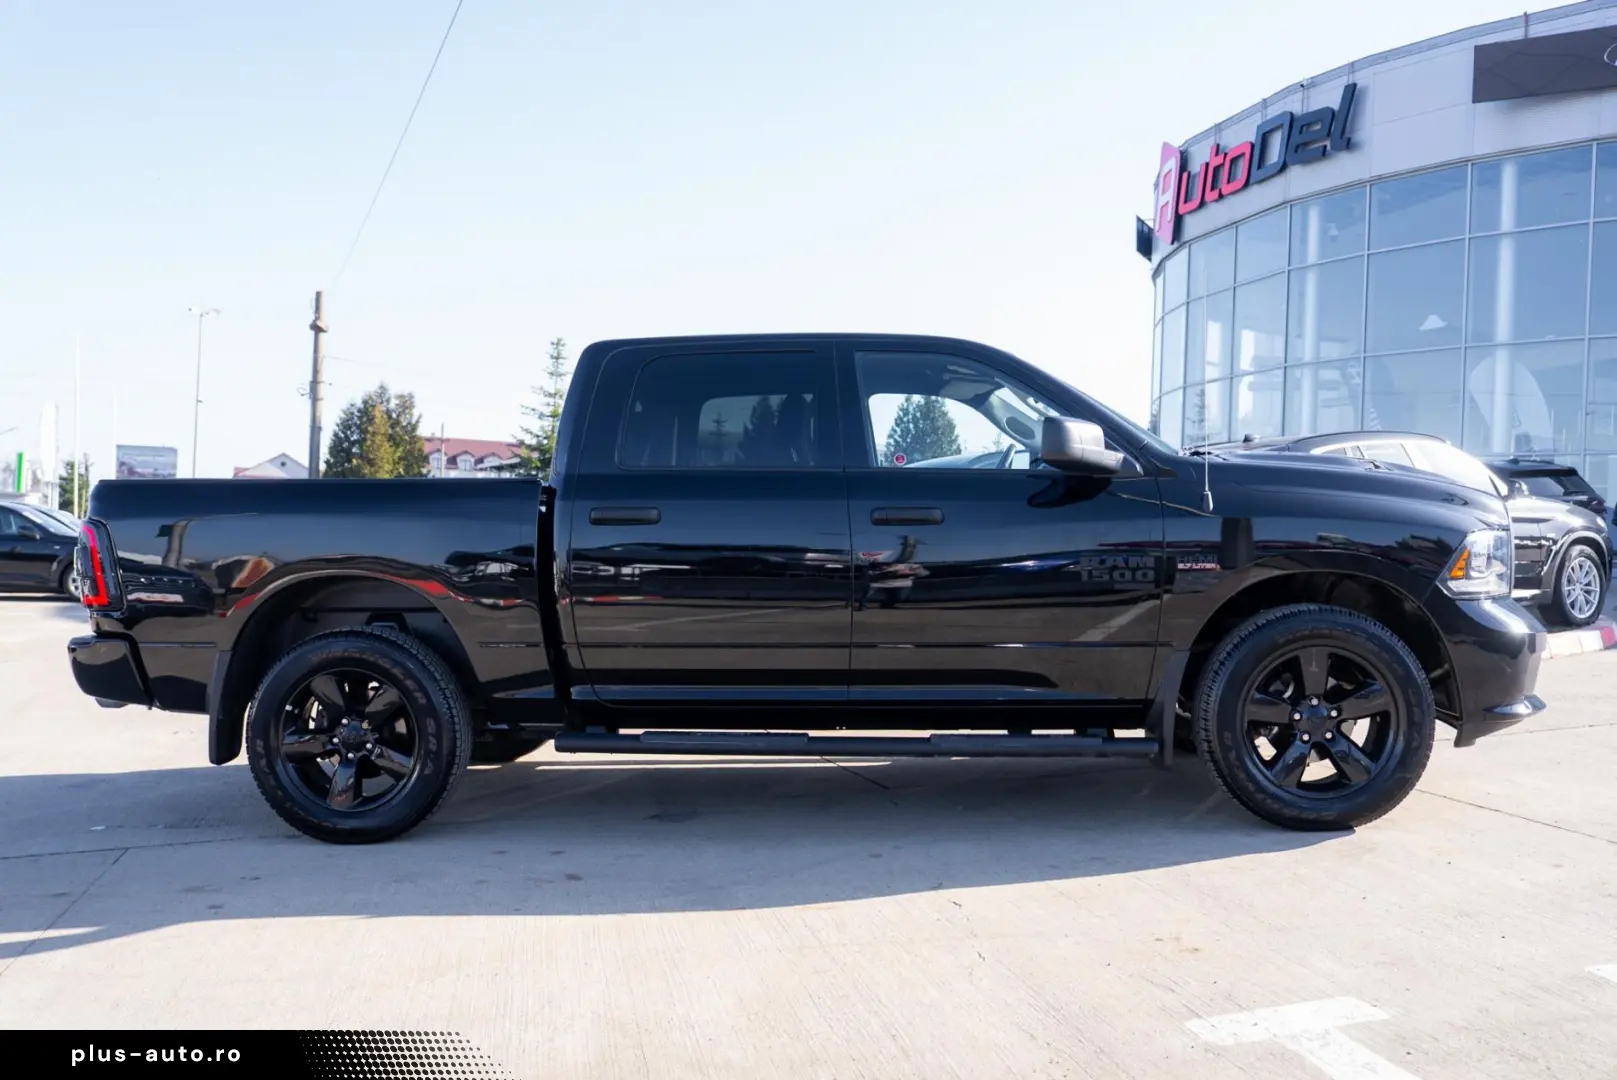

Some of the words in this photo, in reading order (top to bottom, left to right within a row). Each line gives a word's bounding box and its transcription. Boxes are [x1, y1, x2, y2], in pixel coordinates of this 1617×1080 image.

[1154, 83, 1357, 234] AutoDel
[1080, 556, 1155, 568] RAM
[1081, 569, 1155, 582] 1500
